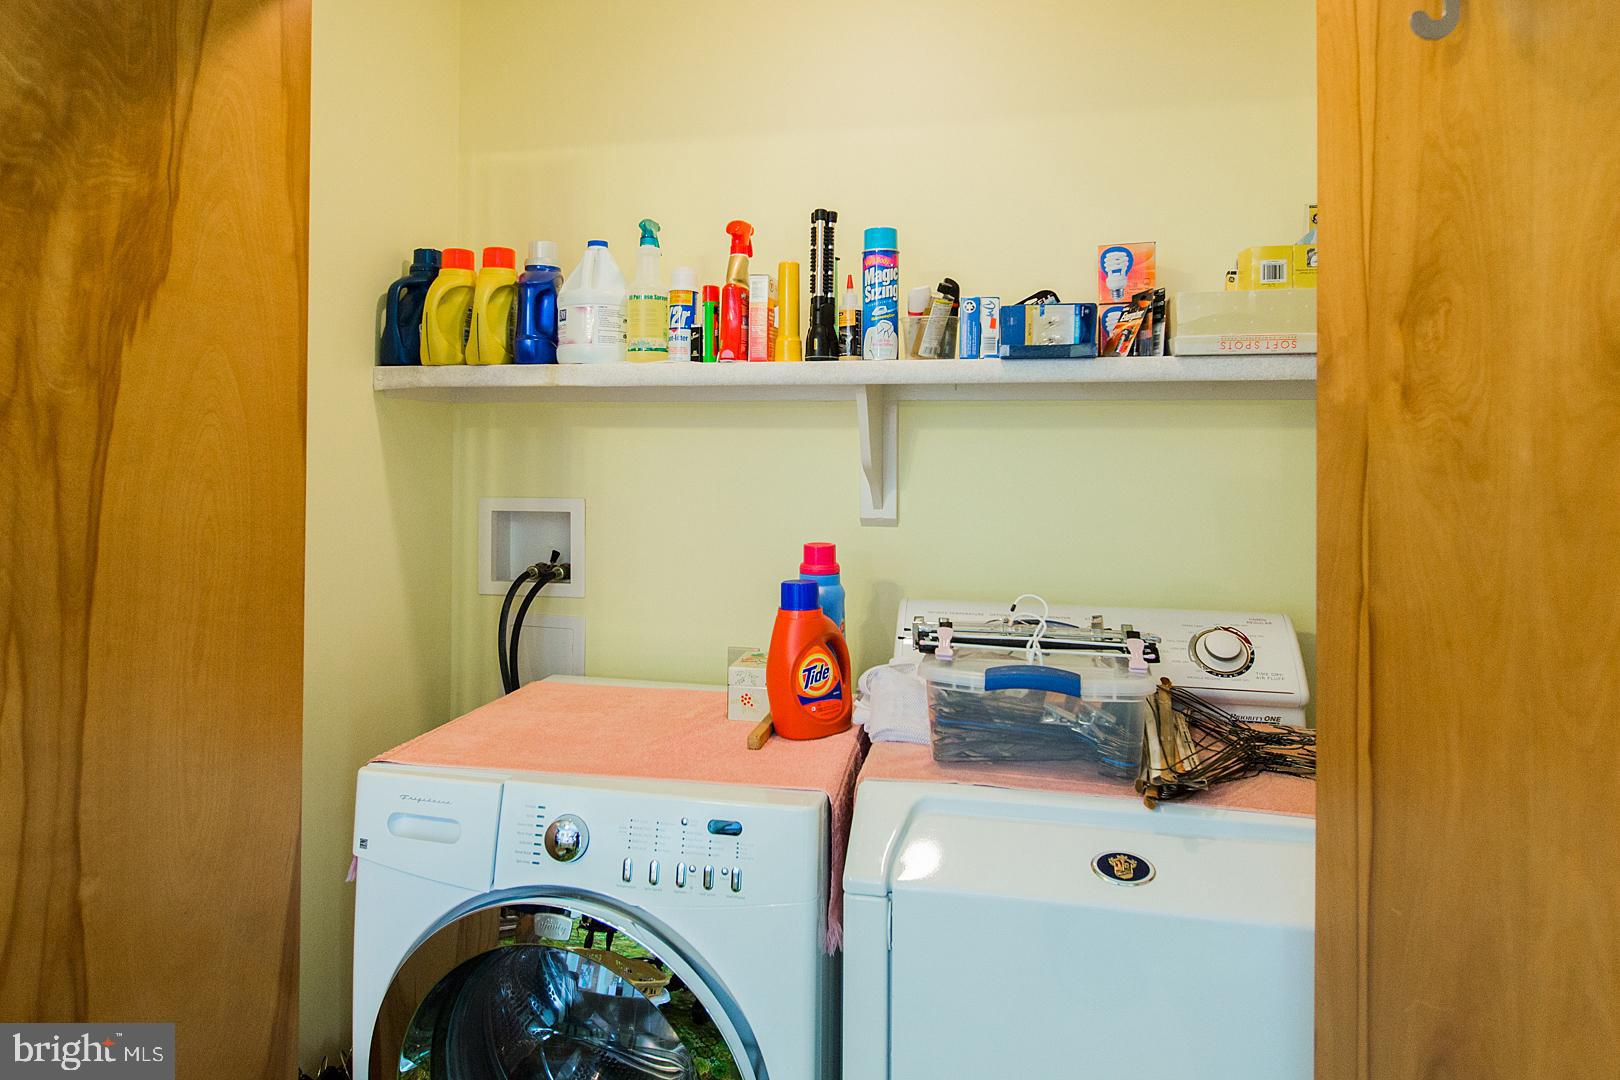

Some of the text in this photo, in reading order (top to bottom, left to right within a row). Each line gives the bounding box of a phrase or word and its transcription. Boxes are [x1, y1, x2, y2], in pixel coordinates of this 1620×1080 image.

[865, 264, 898, 287] Magic
[865, 284, 898, 303] Sizing
[1219, 339, 1297, 350] SOFT SPOTS
[802, 663, 830, 690] Tide
